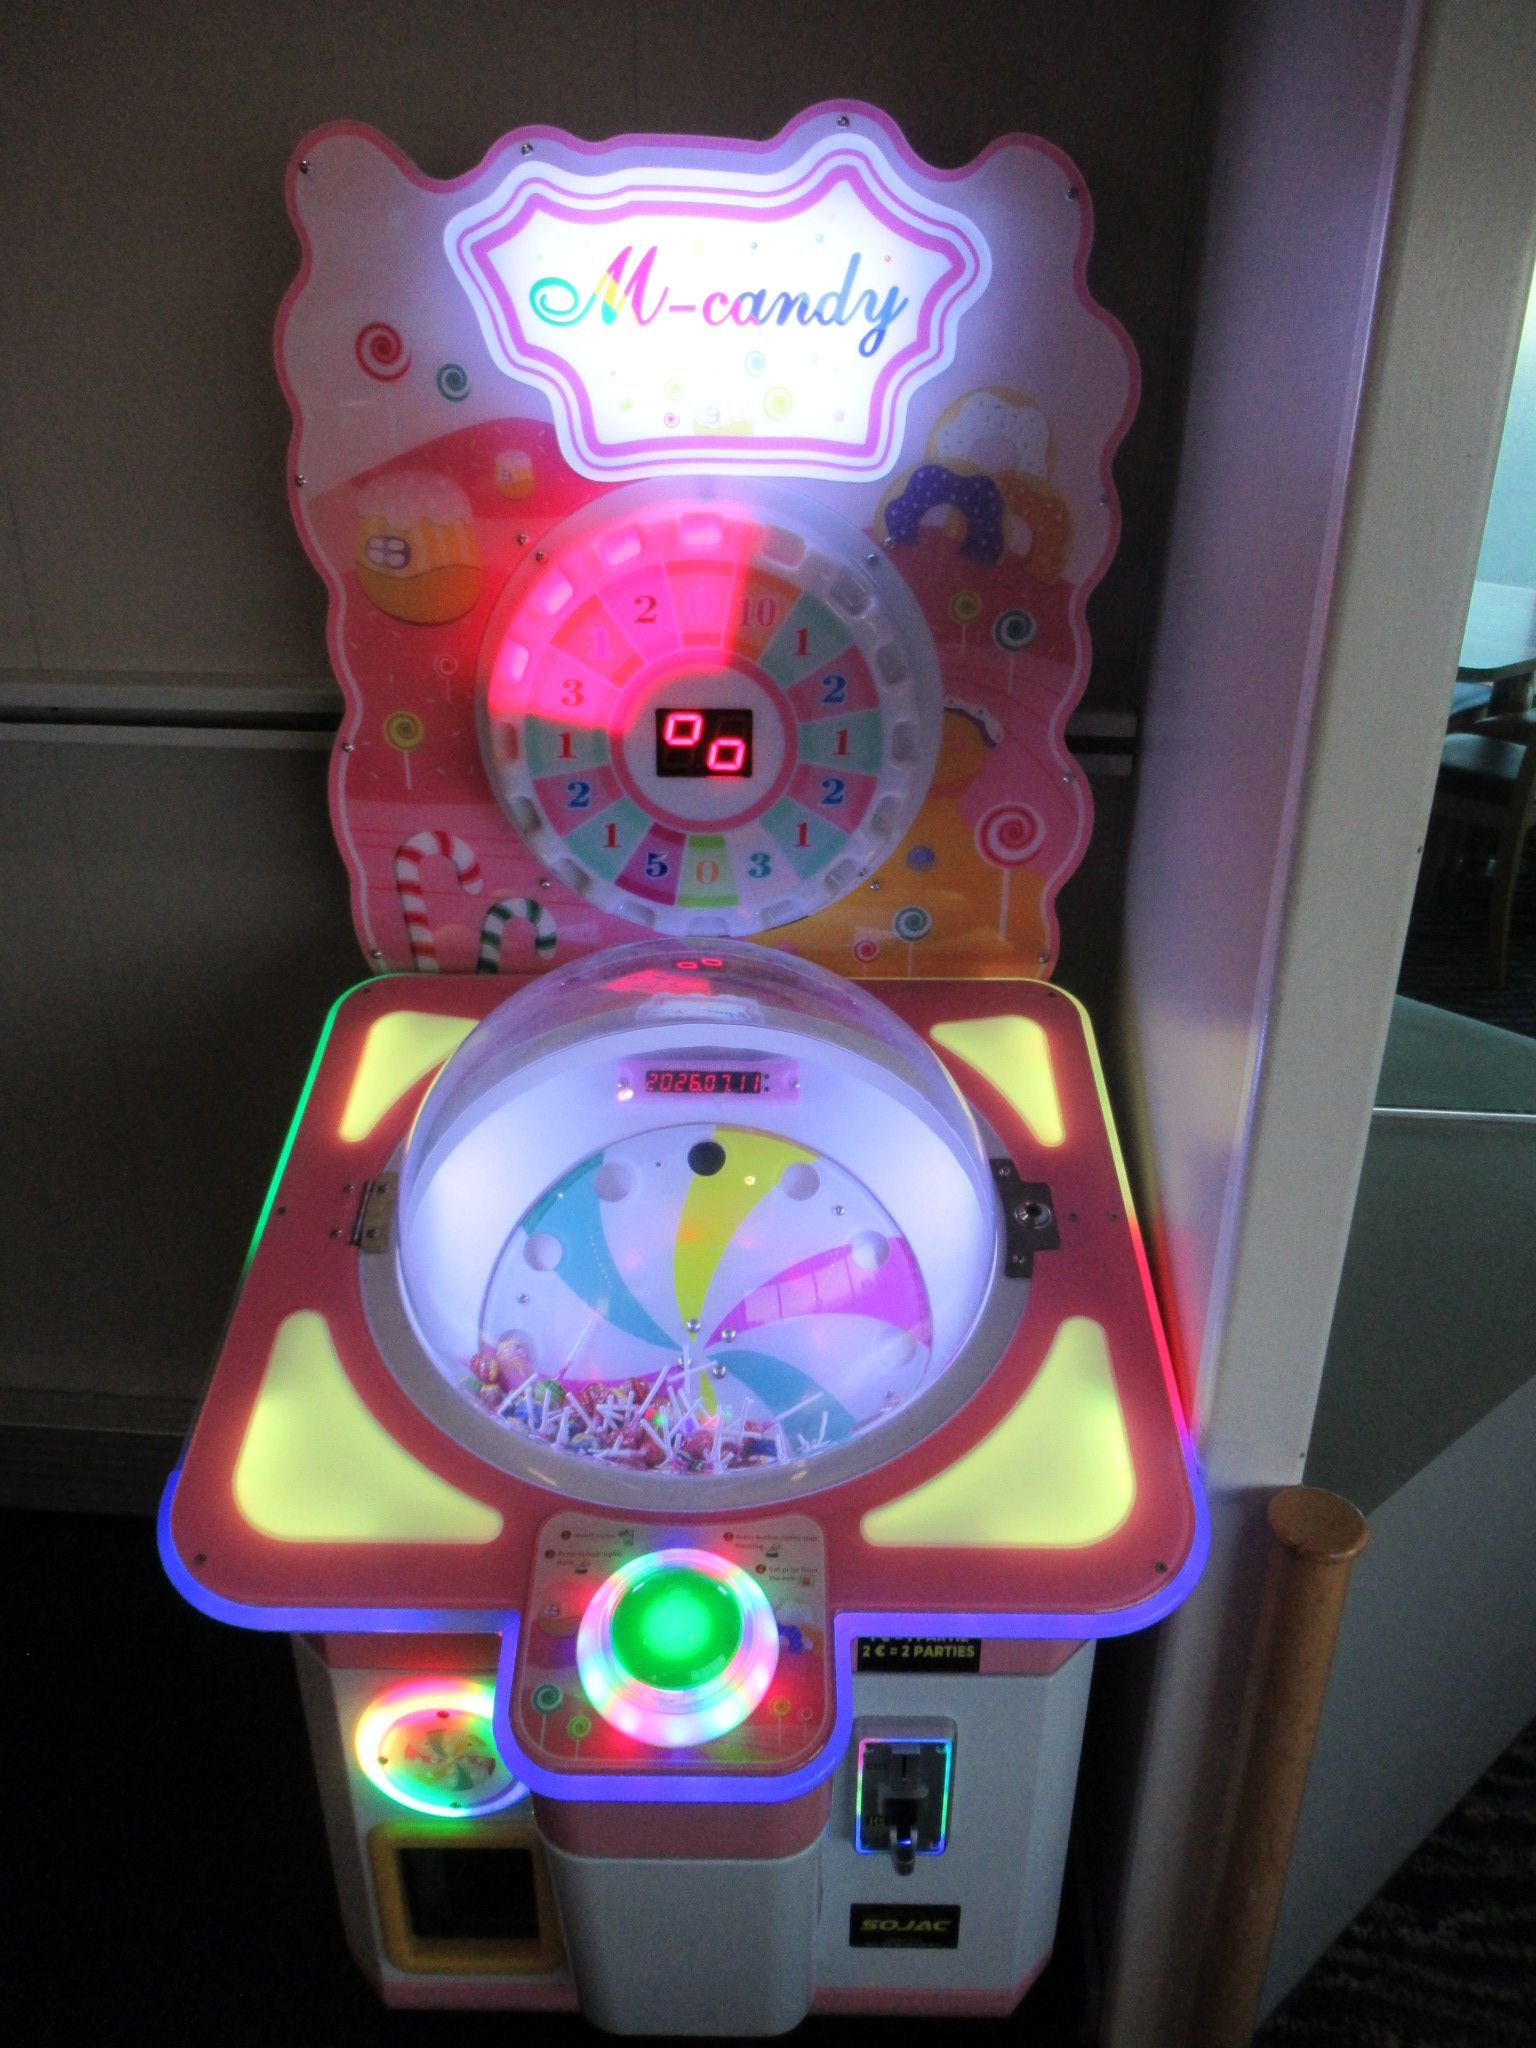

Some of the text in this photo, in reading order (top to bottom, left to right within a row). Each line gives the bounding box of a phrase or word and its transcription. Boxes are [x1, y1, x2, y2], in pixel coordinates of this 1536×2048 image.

[529, 245, 909, 357] M-candy
[634, 595, 658, 624] 2
[738, 597, 776, 627] 10
[594, 629, 613, 657] 1
[795, 628, 812, 656] 1
[561, 679, 585, 707] 3
[822, 676, 846, 704] 2
[558, 732, 576, 758] 1
[834, 729, 851, 756] 1
[567, 782, 591, 808] 2
[821, 779, 845, 805] 2
[604, 823, 622, 848] 1
[794, 822, 812, 848] 1
[645, 853, 668, 878] 5
[696, 859, 719, 885] 0
[748, 853, 772, 879] 3
[862, 1645, 976, 1658] 2 € = 2 PARTIES
[861, 1919, 950, 1932] SOJAC
